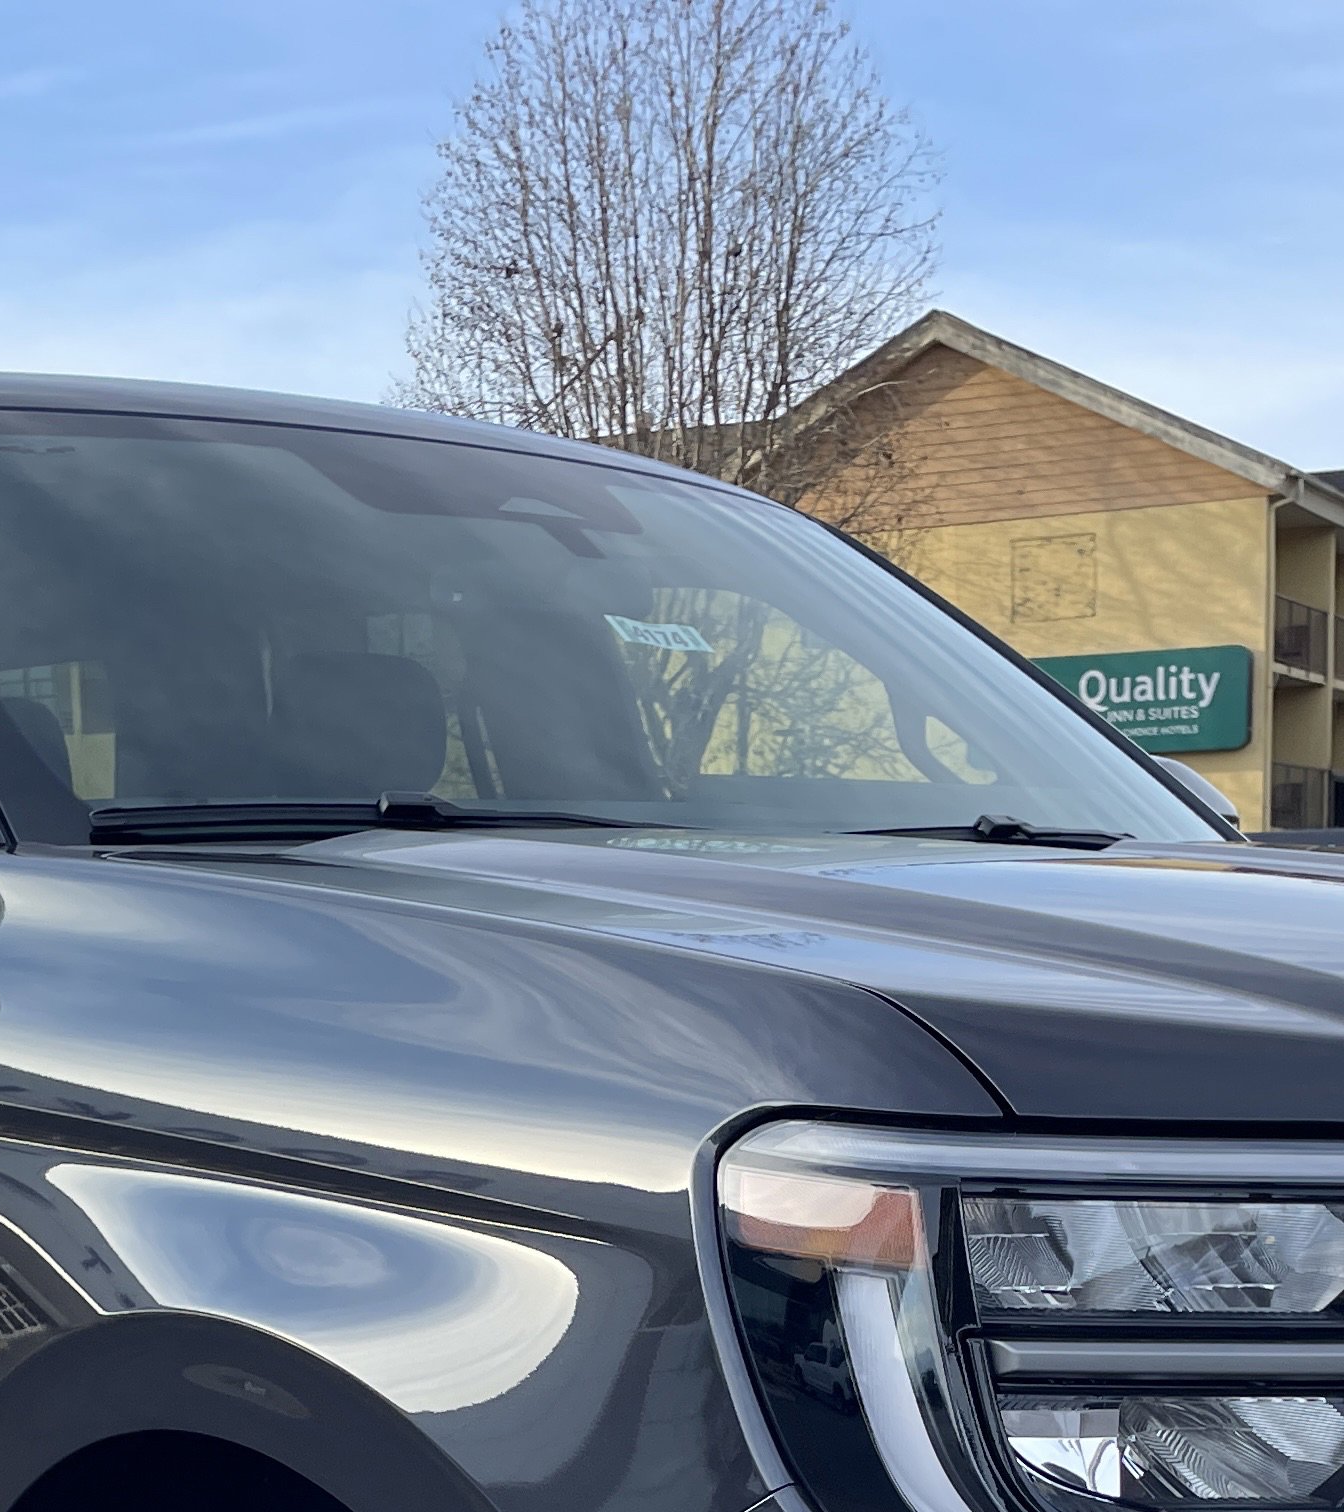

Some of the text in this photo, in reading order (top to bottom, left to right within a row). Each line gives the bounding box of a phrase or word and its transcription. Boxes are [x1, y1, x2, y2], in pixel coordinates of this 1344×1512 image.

[1078, 664, 1221, 711] Quality
[1136, 708, 1146, 720] &
[1148, 705, 1199, 720] SUITES
[1160, 724, 1199, 735] HOTELS
